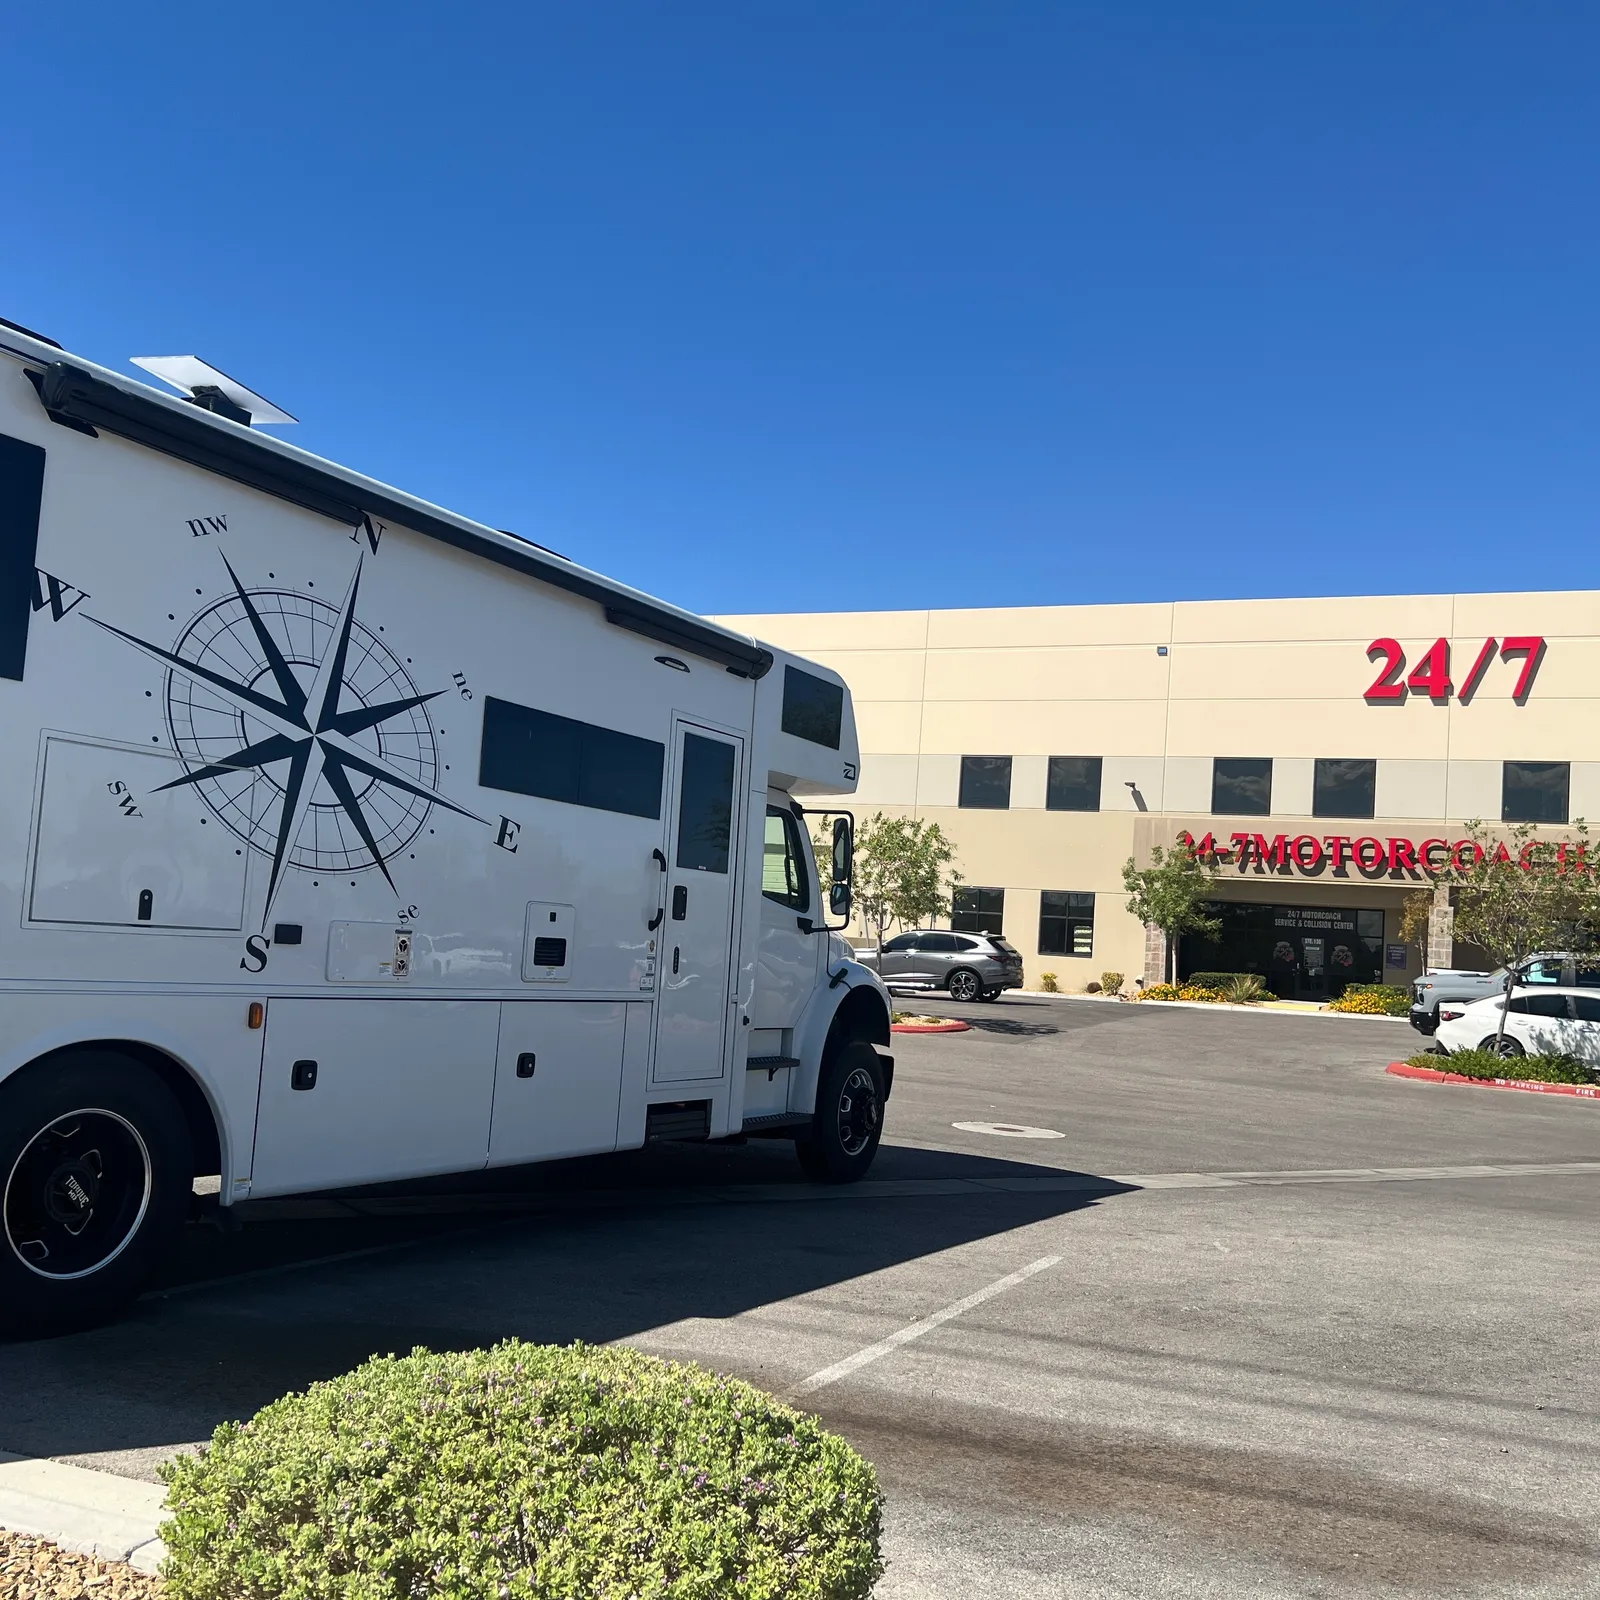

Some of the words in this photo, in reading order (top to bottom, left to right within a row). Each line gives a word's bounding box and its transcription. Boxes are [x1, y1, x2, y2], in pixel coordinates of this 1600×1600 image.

[185, 514, 228, 537] nw
[349, 515, 387, 556] N
[31, 567, 91, 622] W
[451, 670, 473, 701] ne
[1363, 637, 1547, 706] 24/7
[107, 780, 144, 818] sw
[493, 814, 522, 854] E
[397, 904, 420, 924] se
[1274, 918, 1296, 927] SERVICE
[1297, 920, 1303, 928] &
[1303, 920, 1332, 929] COLLISION
[1333, 921, 1354, 930] CENTER
[1287, 910, 1300, 918] 24/7
[1301, 911, 1342, 920] MOTORCOACH
[240, 934, 271, 973] S
[1510, 1081, 1545, 1091] PARKING
[1576, 1088, 1595, 1097] FIRE
[65, 1175, 89, 1208] TORQUE
